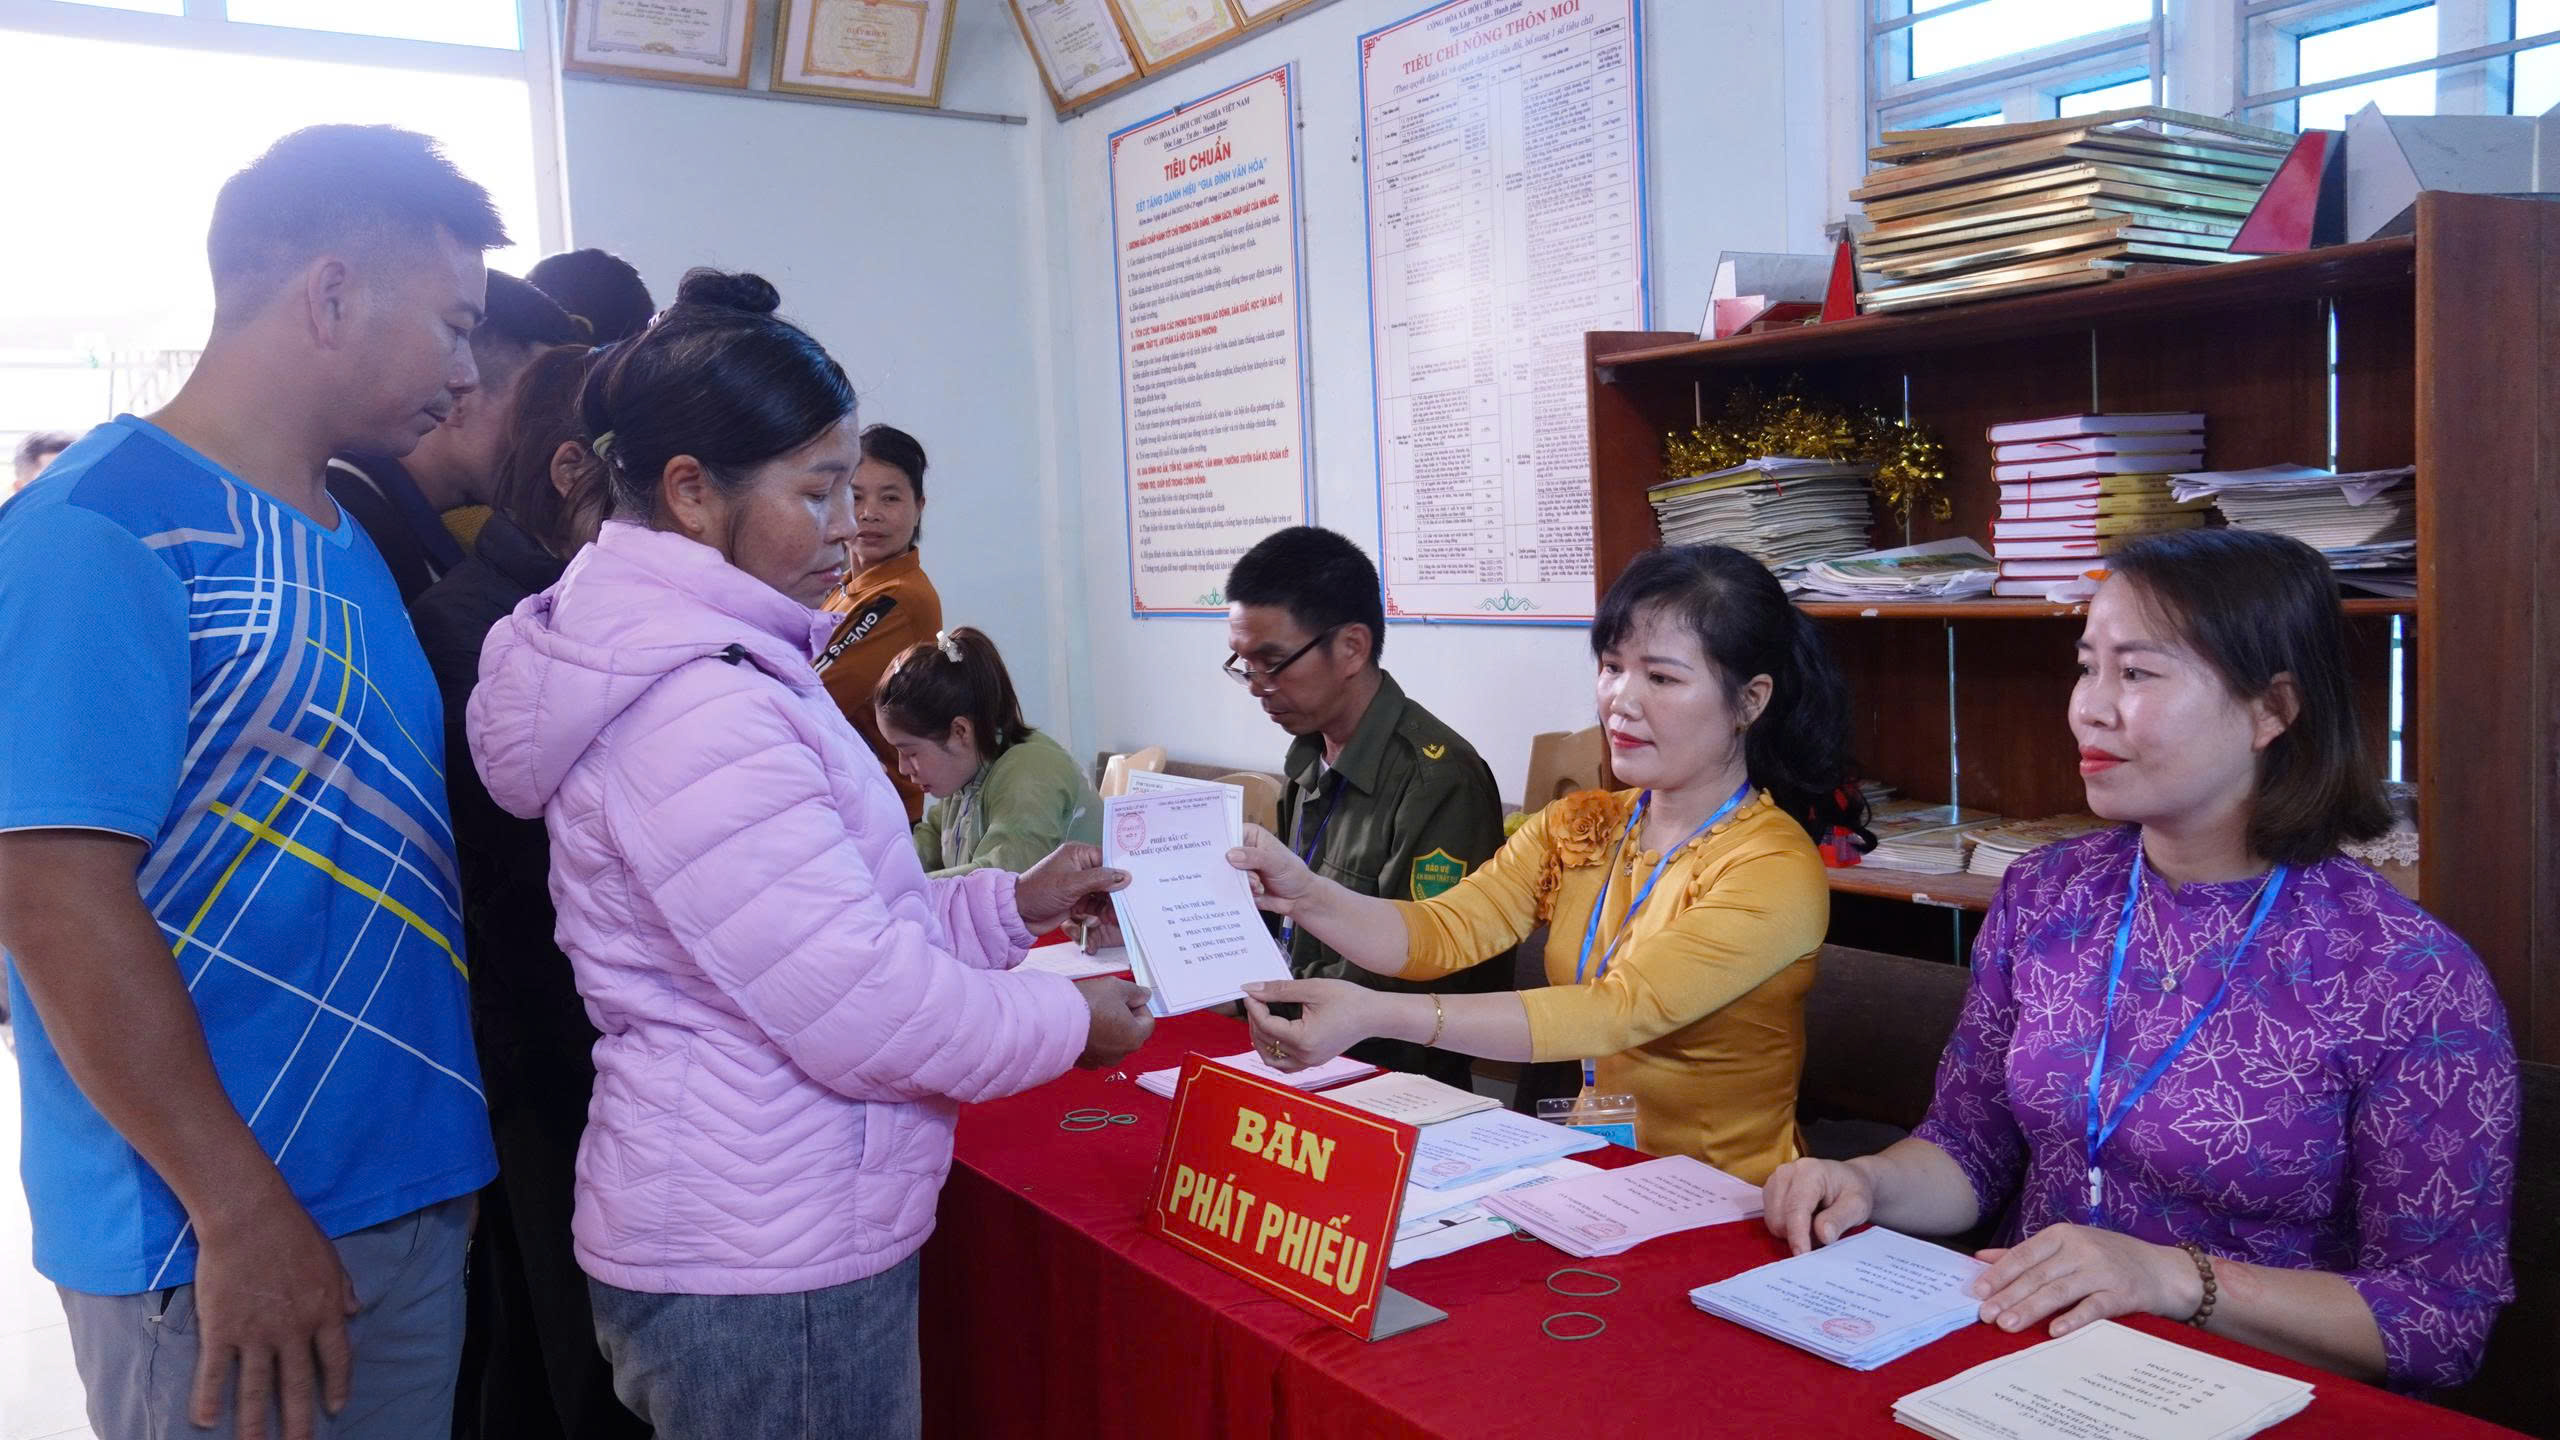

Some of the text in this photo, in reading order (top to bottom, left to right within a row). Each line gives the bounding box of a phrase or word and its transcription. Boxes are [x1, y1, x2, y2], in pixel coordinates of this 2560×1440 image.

[1403, 53, 1432, 74] TIÊU
[1464, 27, 1501, 52] NÔNG
[1505, 9, 1546, 35] THÔN
[1236, 96, 1250, 107] NAM
[1164, 136, 1231, 181] TIÊU CHUẨN
[1164, 190, 1181, 203] DANH
[1182, 183, 1196, 196] HIỆU
[1232, 164, 1246, 179] VĂN
[1231, 1107, 1336, 1182] BÀN
[1169, 1164, 1368, 1295] PHÁT PHIẾU
